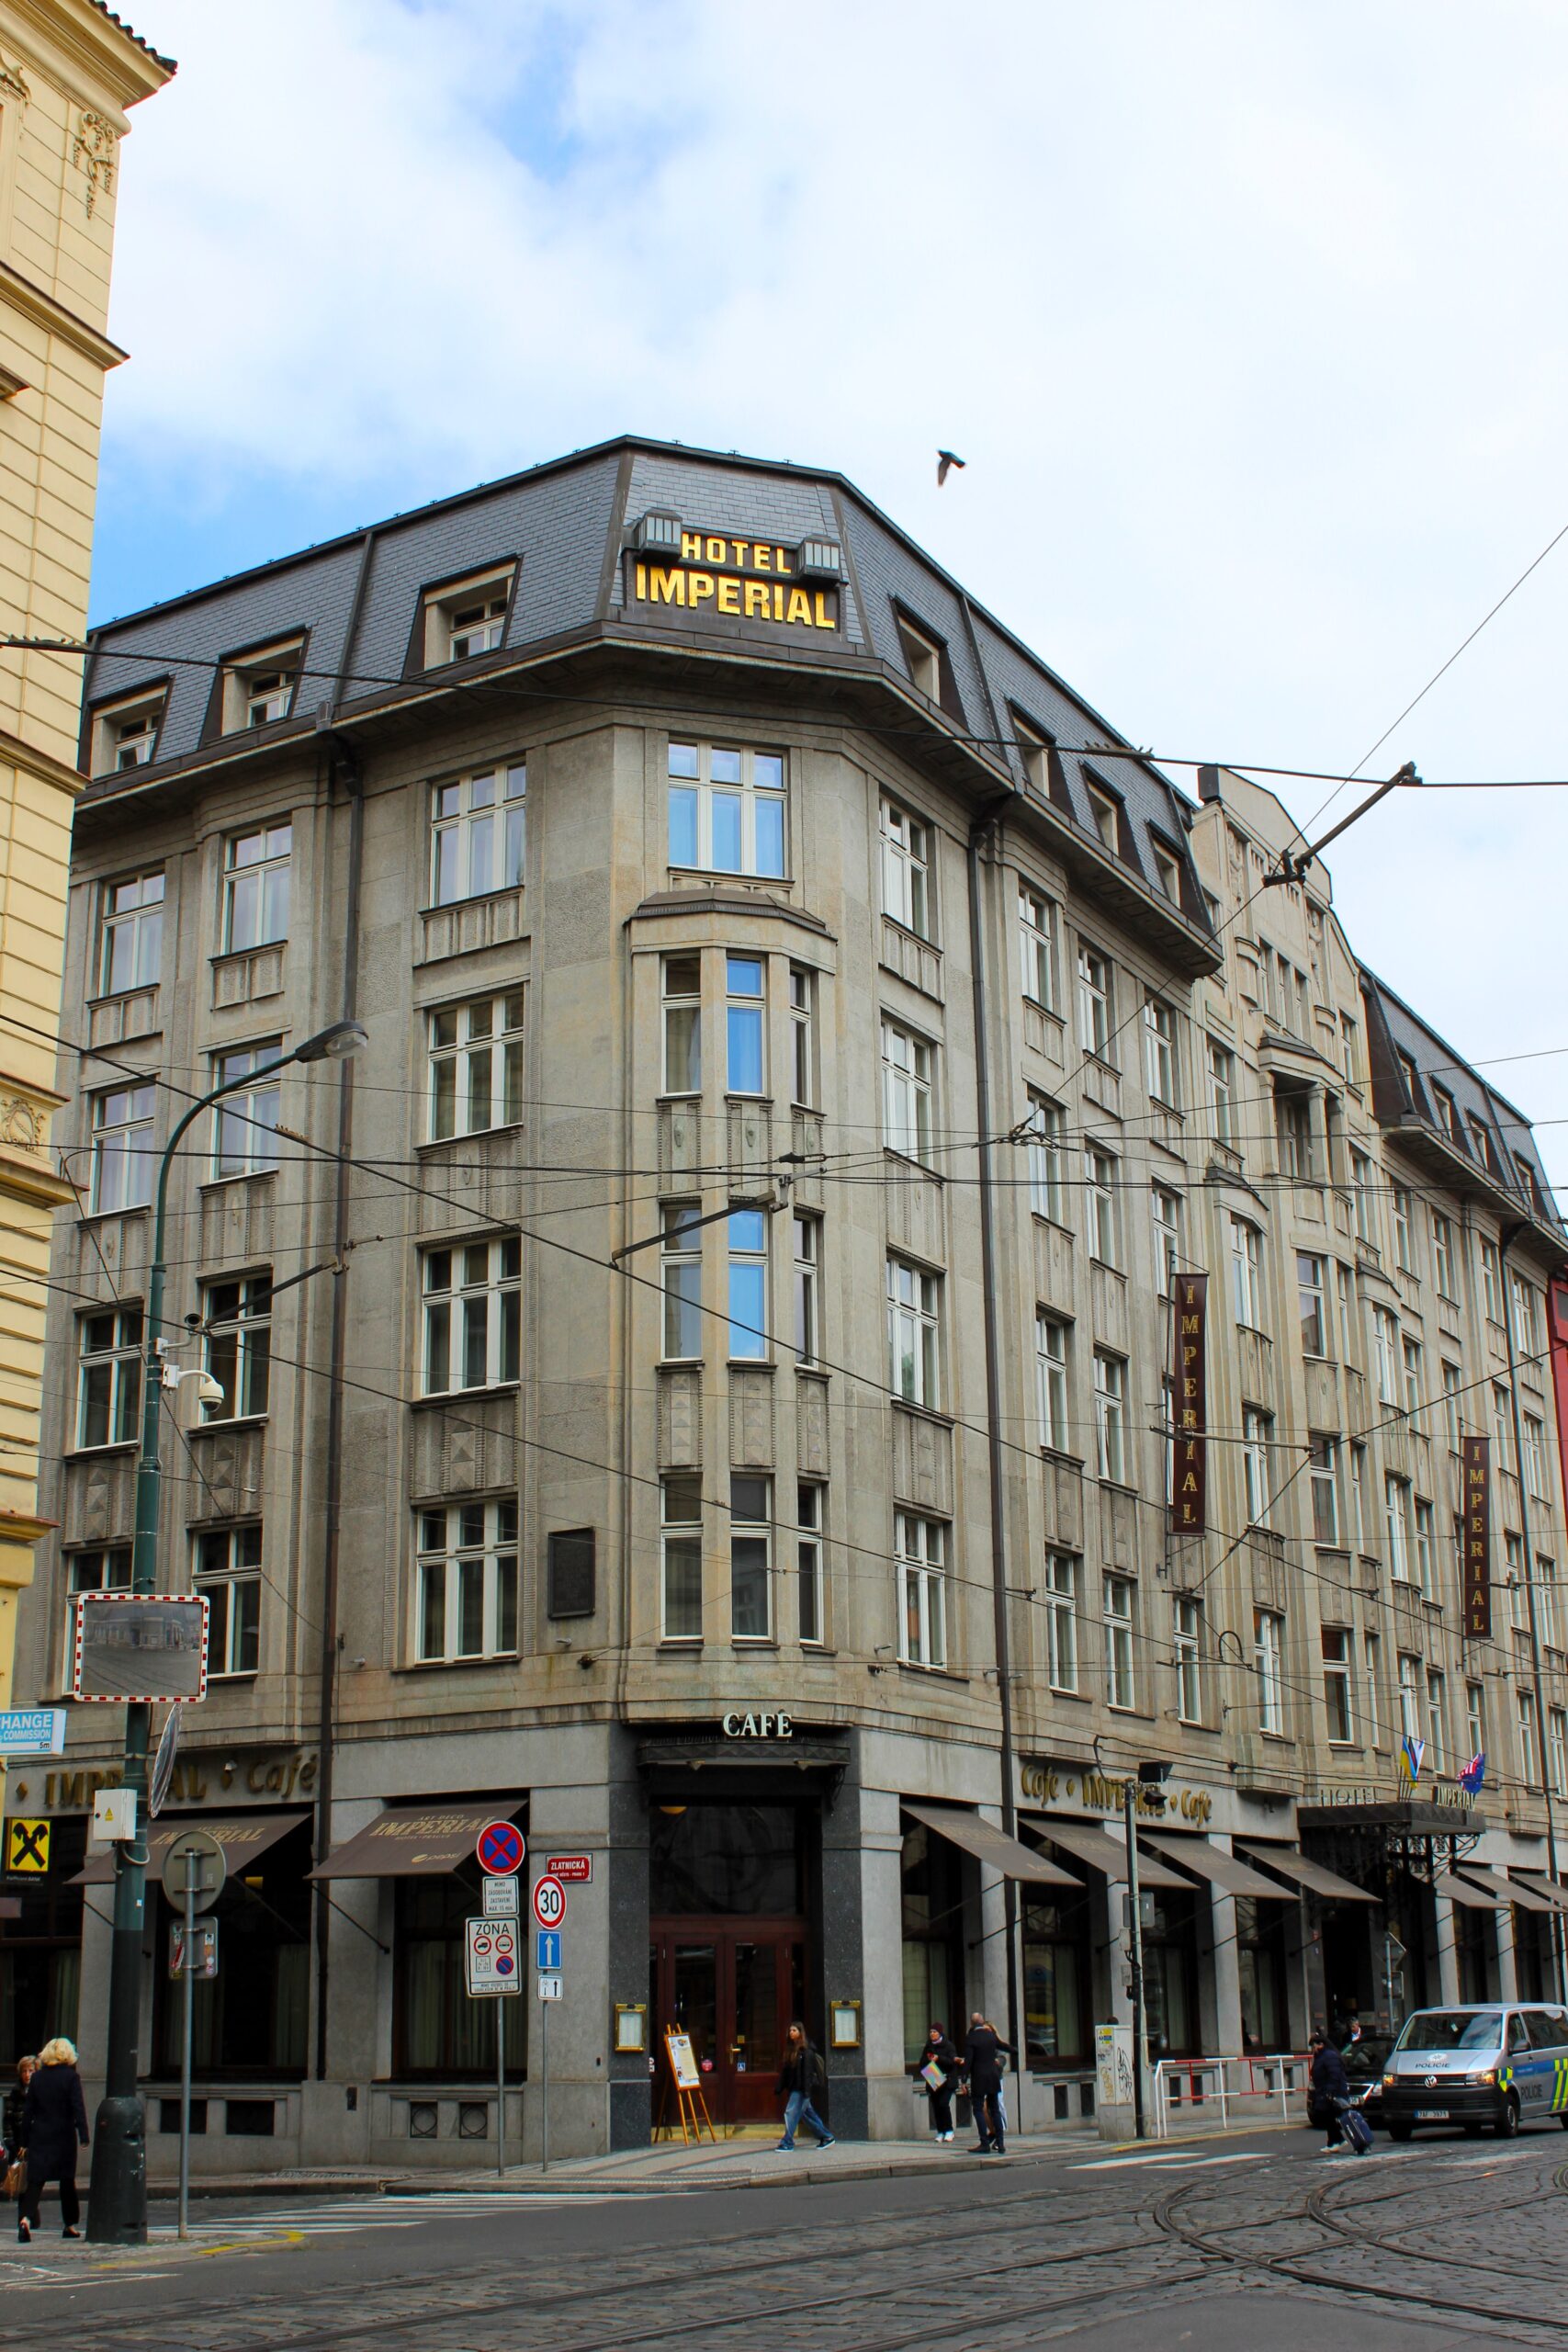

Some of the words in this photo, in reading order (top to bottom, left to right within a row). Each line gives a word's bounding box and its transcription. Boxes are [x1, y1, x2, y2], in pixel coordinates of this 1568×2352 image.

[682, 532, 792, 574] HOTEL
[636, 563, 835, 629] IMPERIAL
[1181, 1285, 1199, 1524] IMPERIAL
[1469, 1446, 1484, 1630] IMPERIAL
[0, 1713, 52, 1729] HANGE
[4, 1729, 51, 1741] COMMISSION
[1436, 1785, 1475, 1812] IMPERIAL
[368, 1815, 496, 1837] IMPERIAL
[551, 1860, 585, 1871] ZLATNICKÁ
[540, 1889, 559, 1915] 30
[476, 1920, 510, 1935] ZÓNA
[1520, 2083, 1543, 2100] POLICIE
